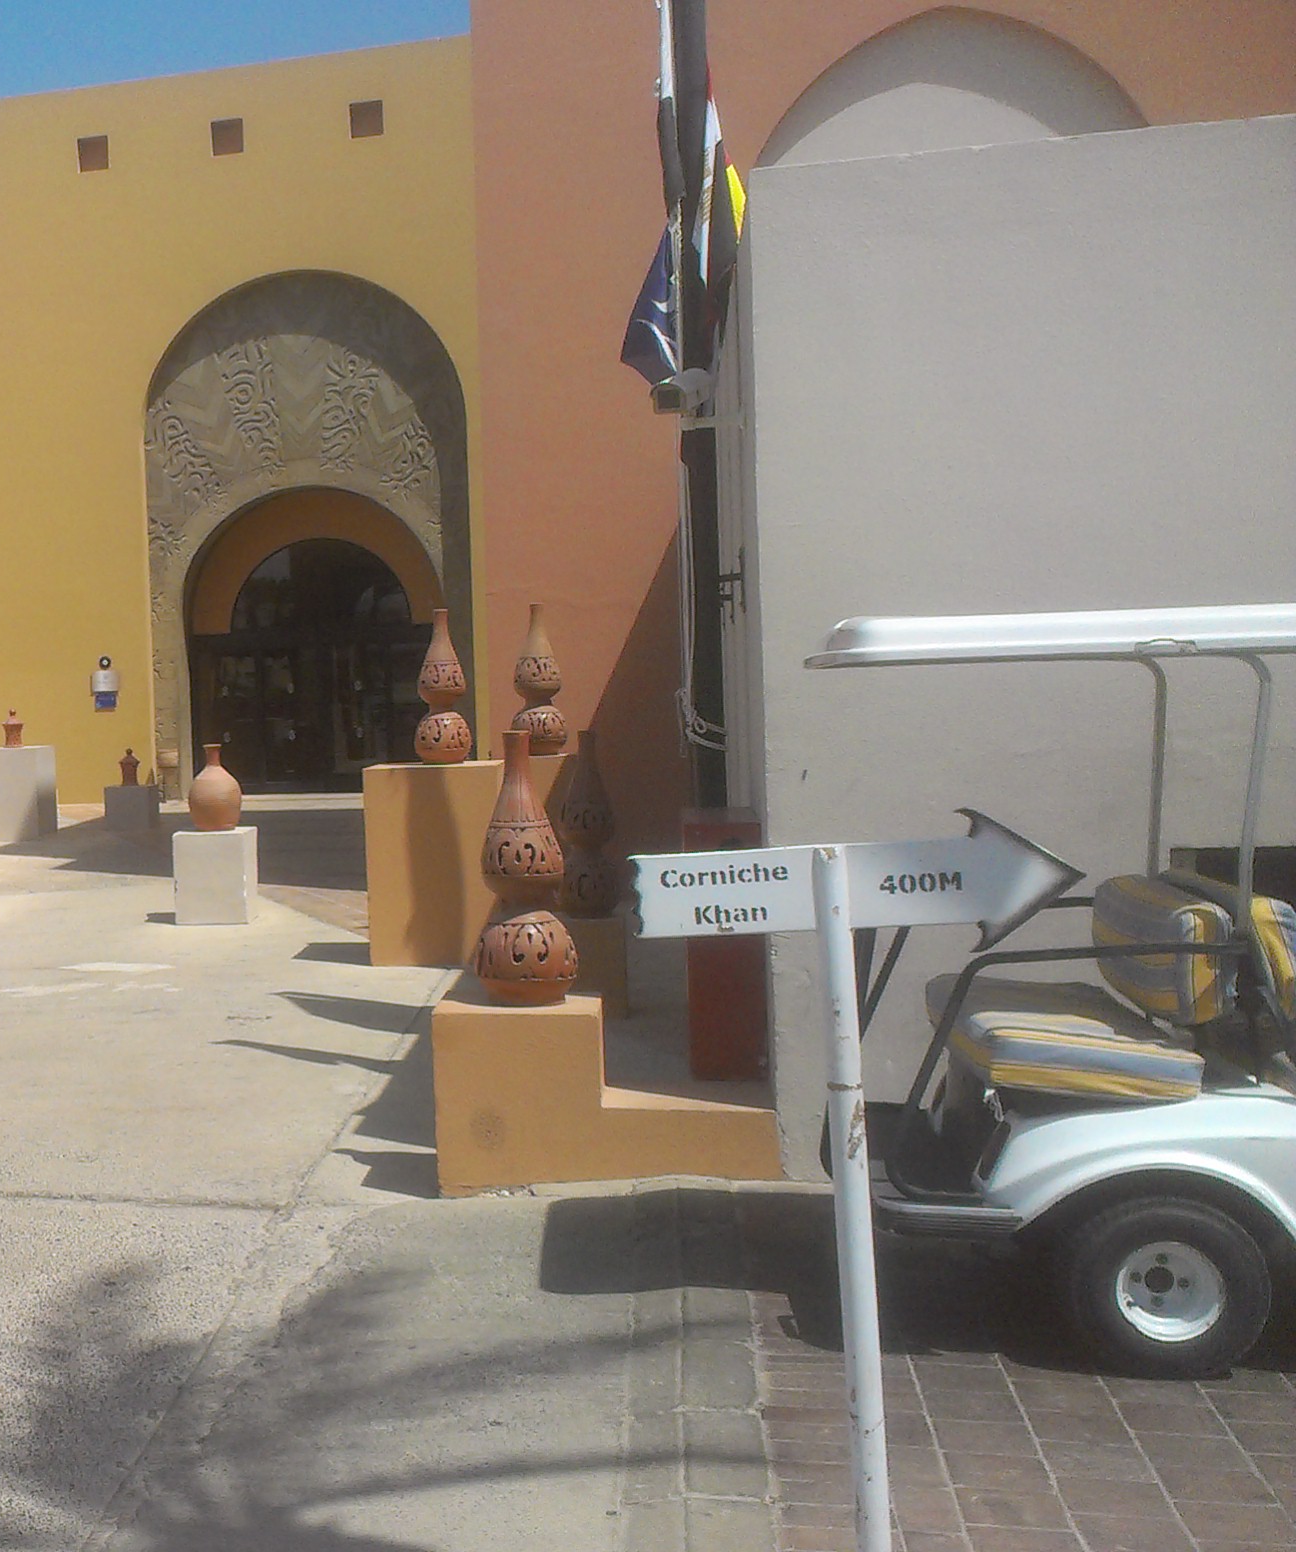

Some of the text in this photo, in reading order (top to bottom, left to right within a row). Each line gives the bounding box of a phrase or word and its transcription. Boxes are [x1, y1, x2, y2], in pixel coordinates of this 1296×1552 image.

[660, 863, 789, 889] Corniche
[879, 871, 963, 895] 400M
[694, 904, 768, 926] Khan
